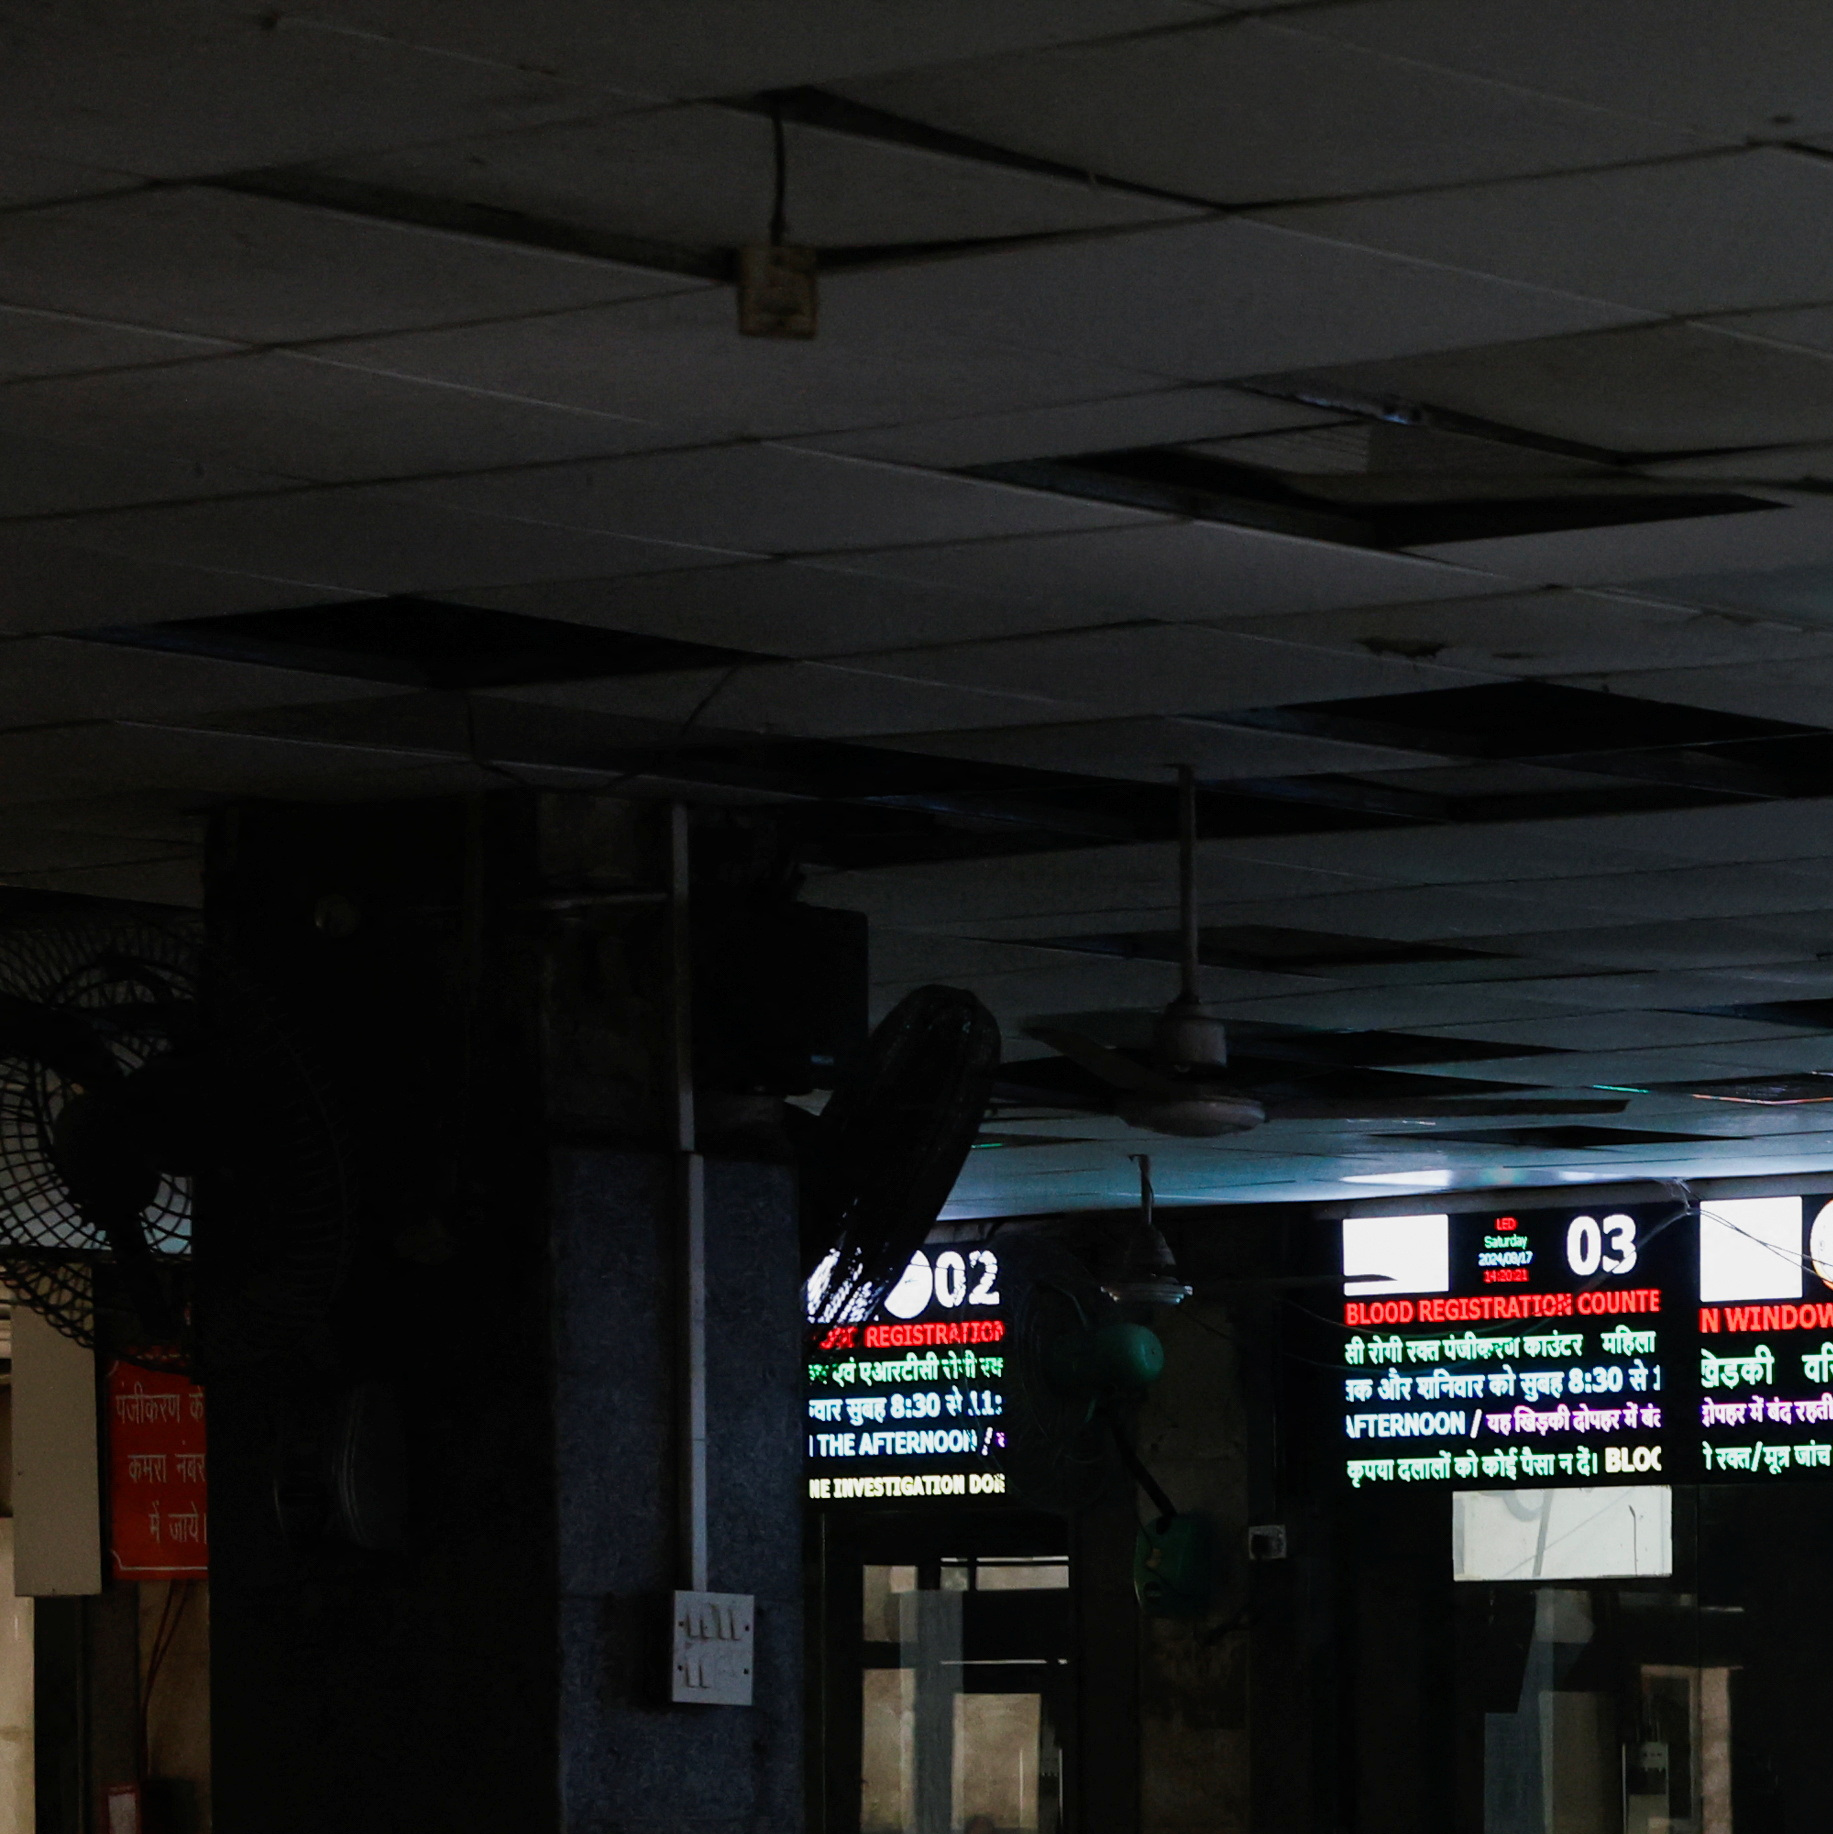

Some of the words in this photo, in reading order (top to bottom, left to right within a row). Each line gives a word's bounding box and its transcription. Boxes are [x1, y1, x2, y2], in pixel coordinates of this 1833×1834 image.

[1496, 1218, 1517, 1230] LED
[1485, 1234, 1527, 1249] Saturday
[1567, 1215, 1636, 1275] 03
[935, 1251, 999, 1307] 02
[1345, 1302, 1414, 1326] BLOOD
[1418, 1293, 1573, 1322] REGISTRATION
[1577, 1289, 1661, 1315] COUNTE
[1368, 1335, 1403, 1364] रोगी
[1406, 1340, 1441, 1362] रक्त
[1442, 1331, 1519, 1360] पंजीकरण
[1523, 1330, 1583, 1357] काउंटर
[1601, 1325, 1656, 1356] महिला
[1378, 1368, 1411, 1400] और
[1416, 1369, 1485, 1400] शनिवार
[1488, 1364, 1515, 1396] को
[1520, 1372, 1564, 1401] सुबह
[1568, 1366, 1623, 1393] 8:30
[1628, 1359, 1648, 1391] से
[115, 1380, 180, 1425] पंजीकरण
[845, 1397, 887, 1426] सुबह
[890, 1392, 940, 1418] 8:30
[1486, 1413, 1512, 1436] यह
[1572, 1403, 1621, 1433] दोपहर
[1622, 1402, 1638, 1428] में
[1749, 1395, 1765, 1422] में
[1767, 1397, 1792, 1424] बंद
[817, 1433, 855, 1457] THE
[859, 1429, 977, 1455] AFTERNOON
[1794, 1440, 1831, 1466] जांच
[127, 1453, 168, 1484] कमरा
[1347, 1460, 1394, 1488] कृपया
[1397, 1450, 1451, 1482] दलालों
[1454, 1449, 1478, 1478] को
[1481, 1447, 1518, 1480] कोई
[1520, 1447, 1555, 1476] पैसा
[1558, 1453, 1573, 1474] न
[810, 1479, 830, 1498] NE
[833, 1475, 965, 1498] INVESTIGATION
